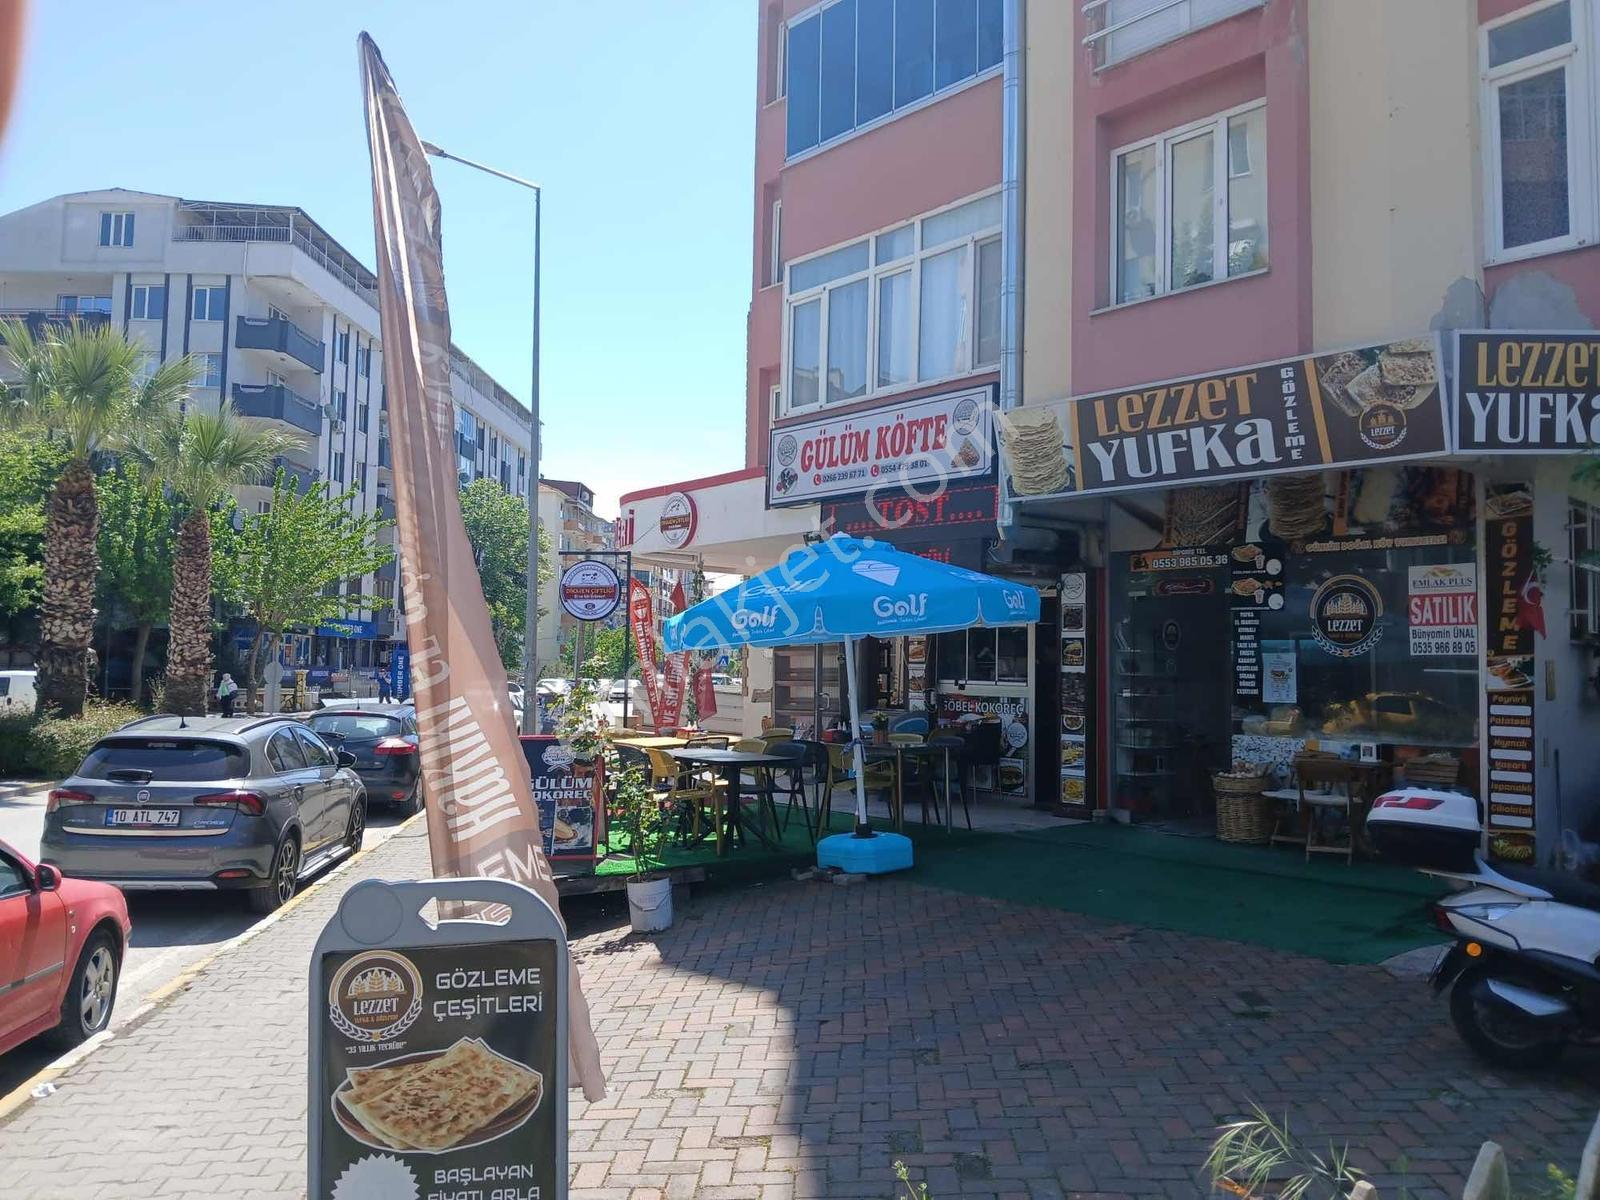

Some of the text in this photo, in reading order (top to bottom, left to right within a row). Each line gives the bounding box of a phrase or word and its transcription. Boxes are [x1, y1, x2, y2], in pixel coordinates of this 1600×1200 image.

[1465, 392, 1600, 444] YUFK
[801, 413, 948, 473] GÜLÜM KÖFTE
[1499, 521, 1520, 651] GÖZLEME
[732, 604, 782, 630] Golf
[873, 592, 929, 618] Golf
[1411, 595, 1476, 624] SATILIK
[1412, 626, 1475, 641] Bünyamin ÜNAL
[1413, 641, 1476, 654] 0535 966 89 05
[532, 790, 593, 801] OKOREÇ
[114, 811, 177, 824] 10 ATL 747
[435, 967, 541, 990] GÖZLEME
[433, 991, 543, 1022] ÇEŞİTLERİ
[434, 1164, 534, 1186] BAŞLAYAN
